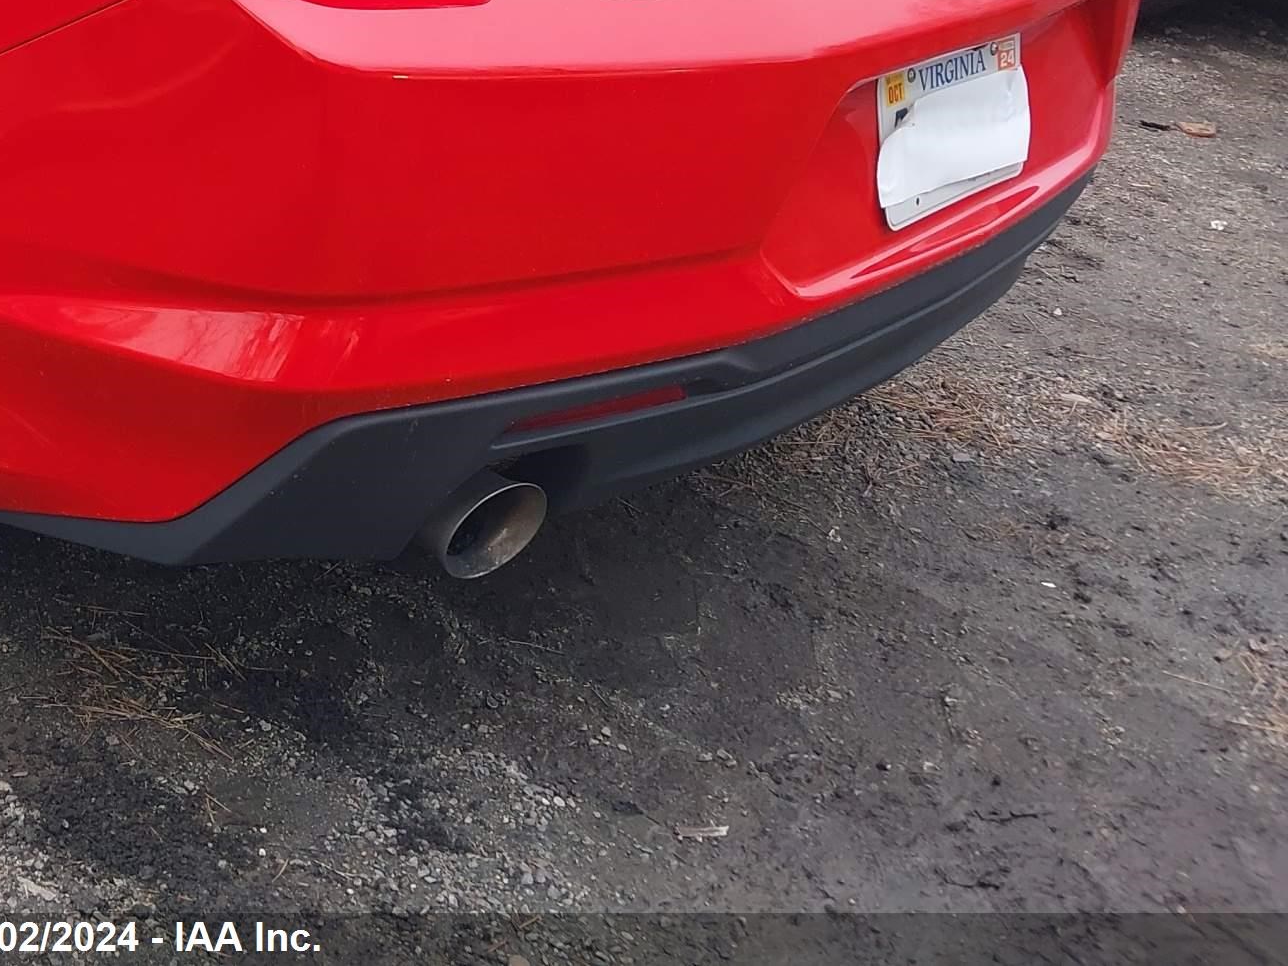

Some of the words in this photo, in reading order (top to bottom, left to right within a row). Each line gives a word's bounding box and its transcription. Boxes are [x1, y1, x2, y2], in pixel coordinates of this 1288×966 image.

[918, 48, 986, 91] VIRGINIA
[1000, 50, 1015, 68] 24
[888, 82, 904, 104] OCT
